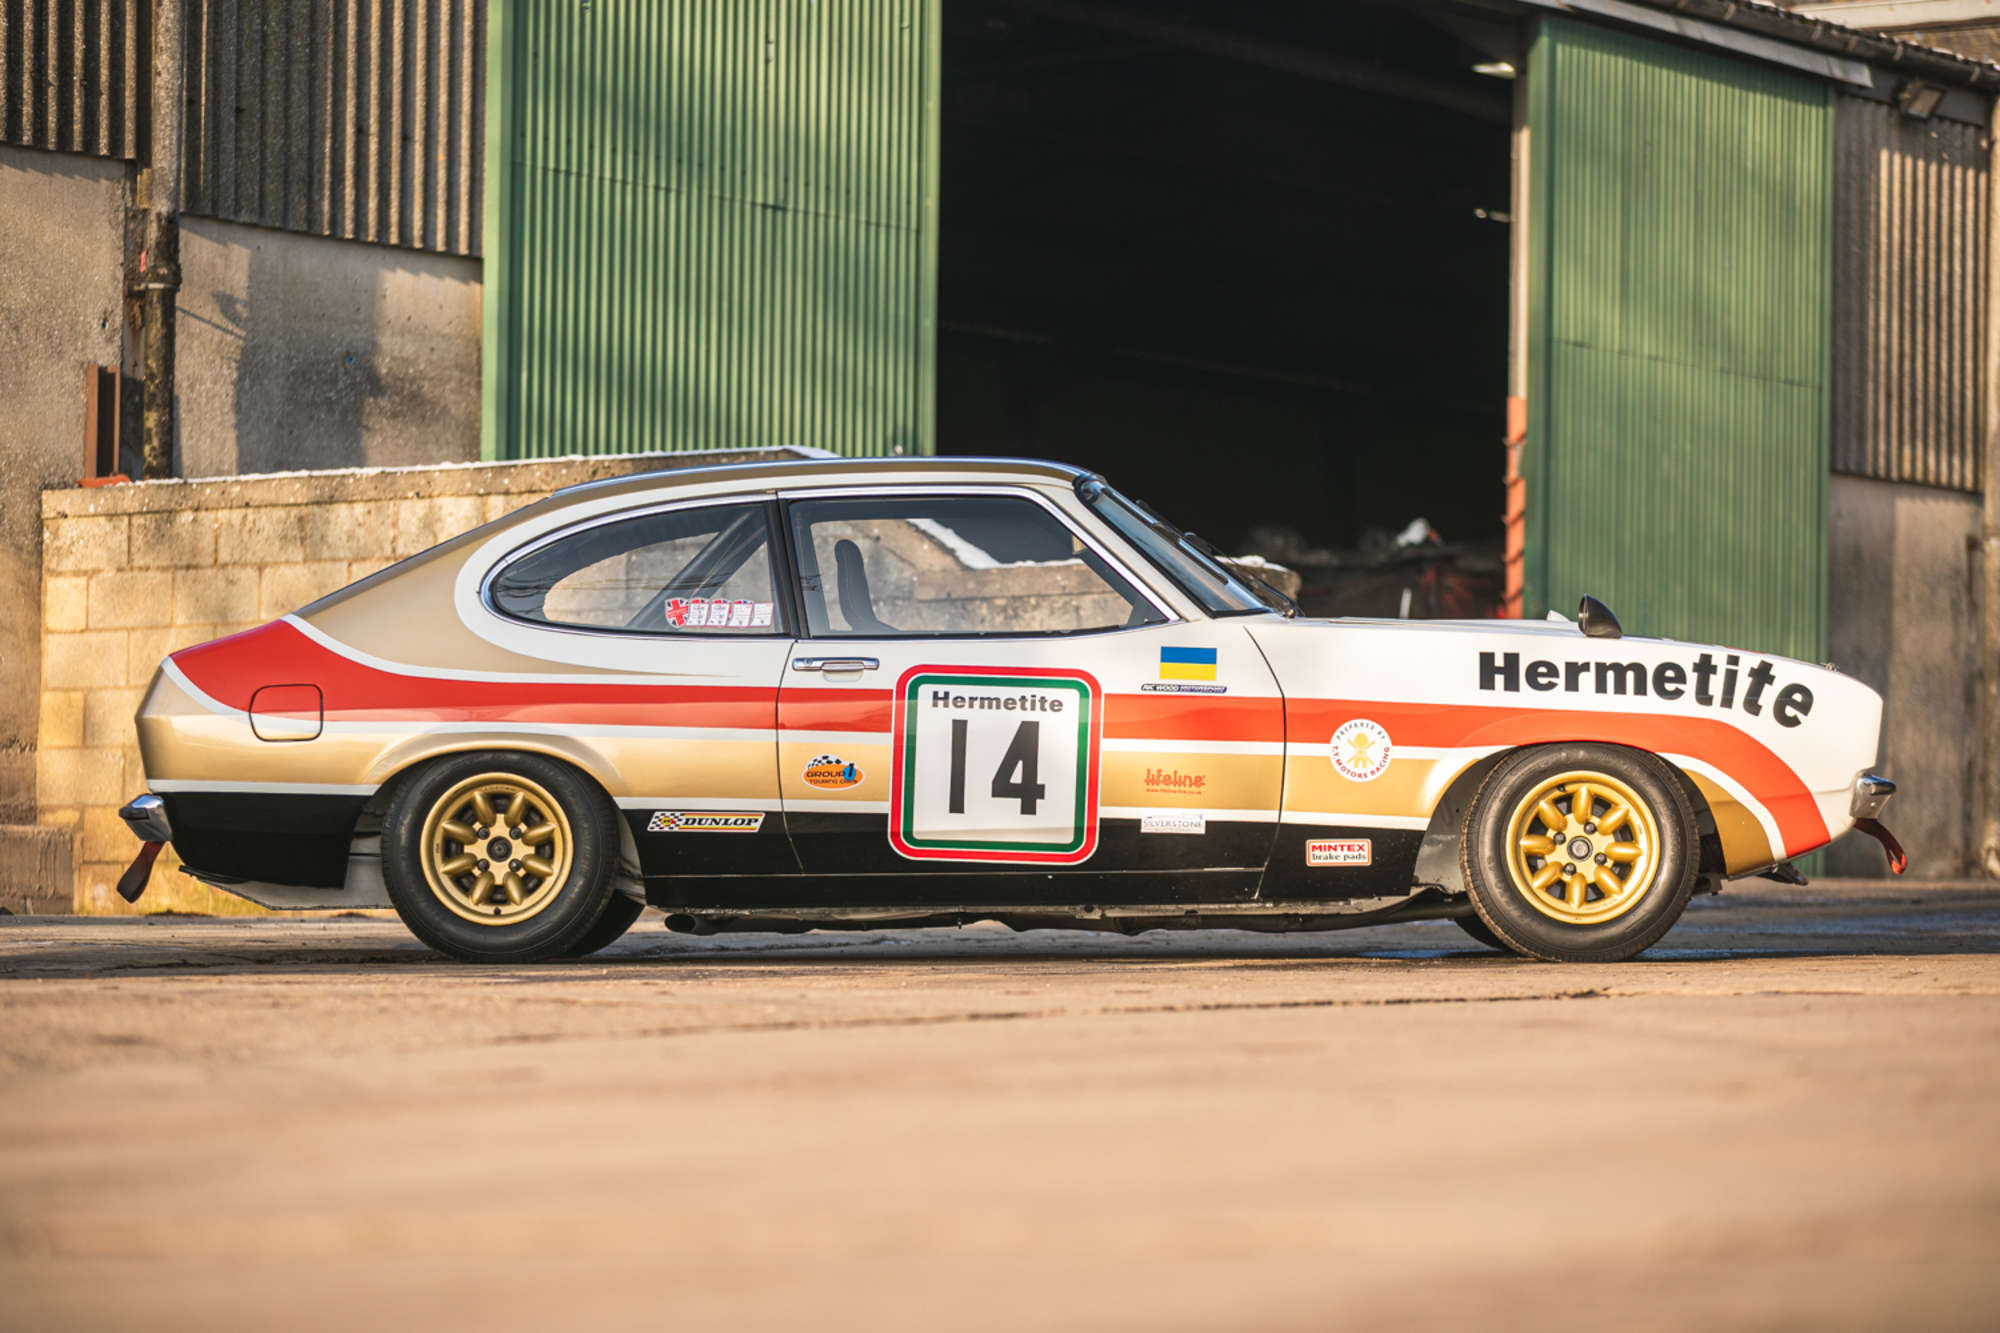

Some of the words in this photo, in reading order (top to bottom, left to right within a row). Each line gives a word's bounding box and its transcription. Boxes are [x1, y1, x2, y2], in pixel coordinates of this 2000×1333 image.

[1479, 651, 1814, 728] Hermetite
[932, 691, 1064, 713] Hermetite
[1336, 722, 1375, 740] PREPARED
[949, 719, 1045, 815] 14
[1370, 746, 1390, 777] RACING
[1144, 769, 1206, 788] lifeline
[683, 818, 759, 826] DUNLOP
[1143, 820, 1201, 829] SILVERSTONE
[1311, 843, 1366, 852] MINTEX
[1311, 853, 1341, 861] brake
[1343, 853, 1366, 862] pads
